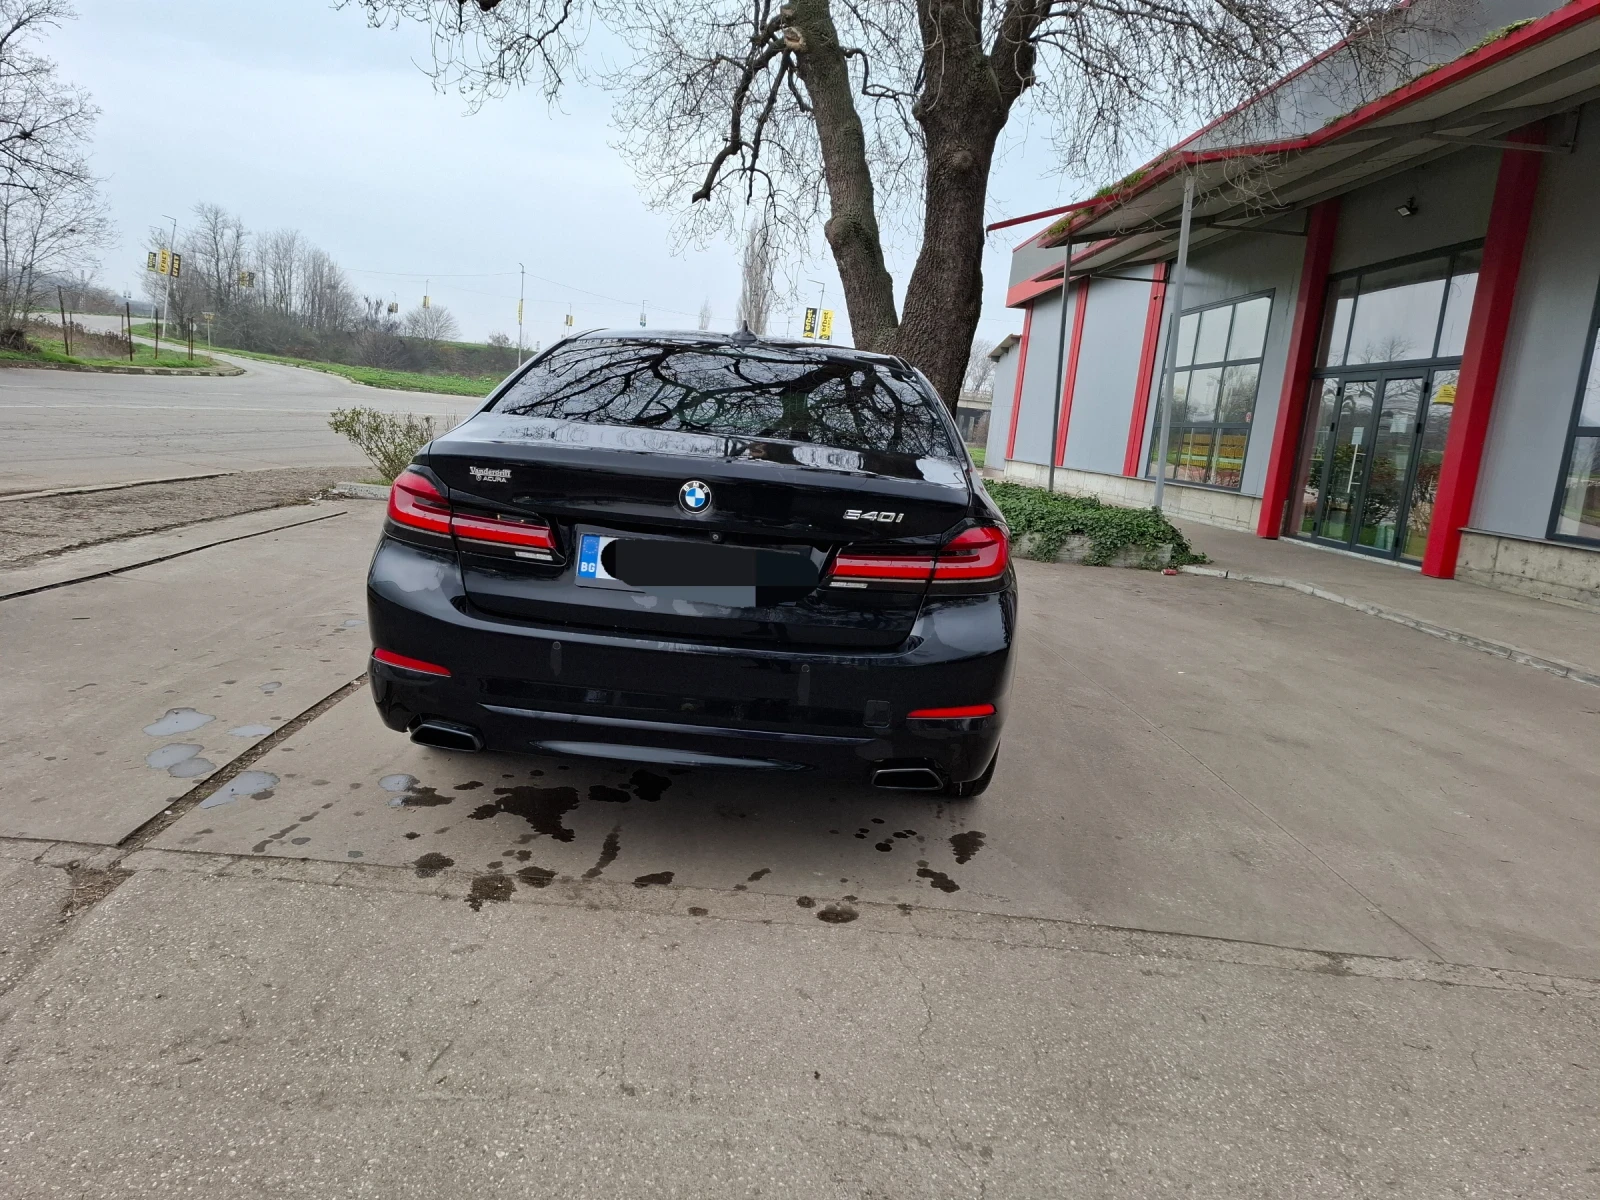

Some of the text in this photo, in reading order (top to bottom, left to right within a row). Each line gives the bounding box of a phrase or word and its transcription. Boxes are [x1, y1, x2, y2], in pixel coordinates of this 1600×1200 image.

[804, 309, 813, 331] efbet
[821, 311, 829, 332] efbet
[482, 475, 508, 483] ACURA
[682, 481, 709, 494] BMW
[580, 561, 596, 573] BG
